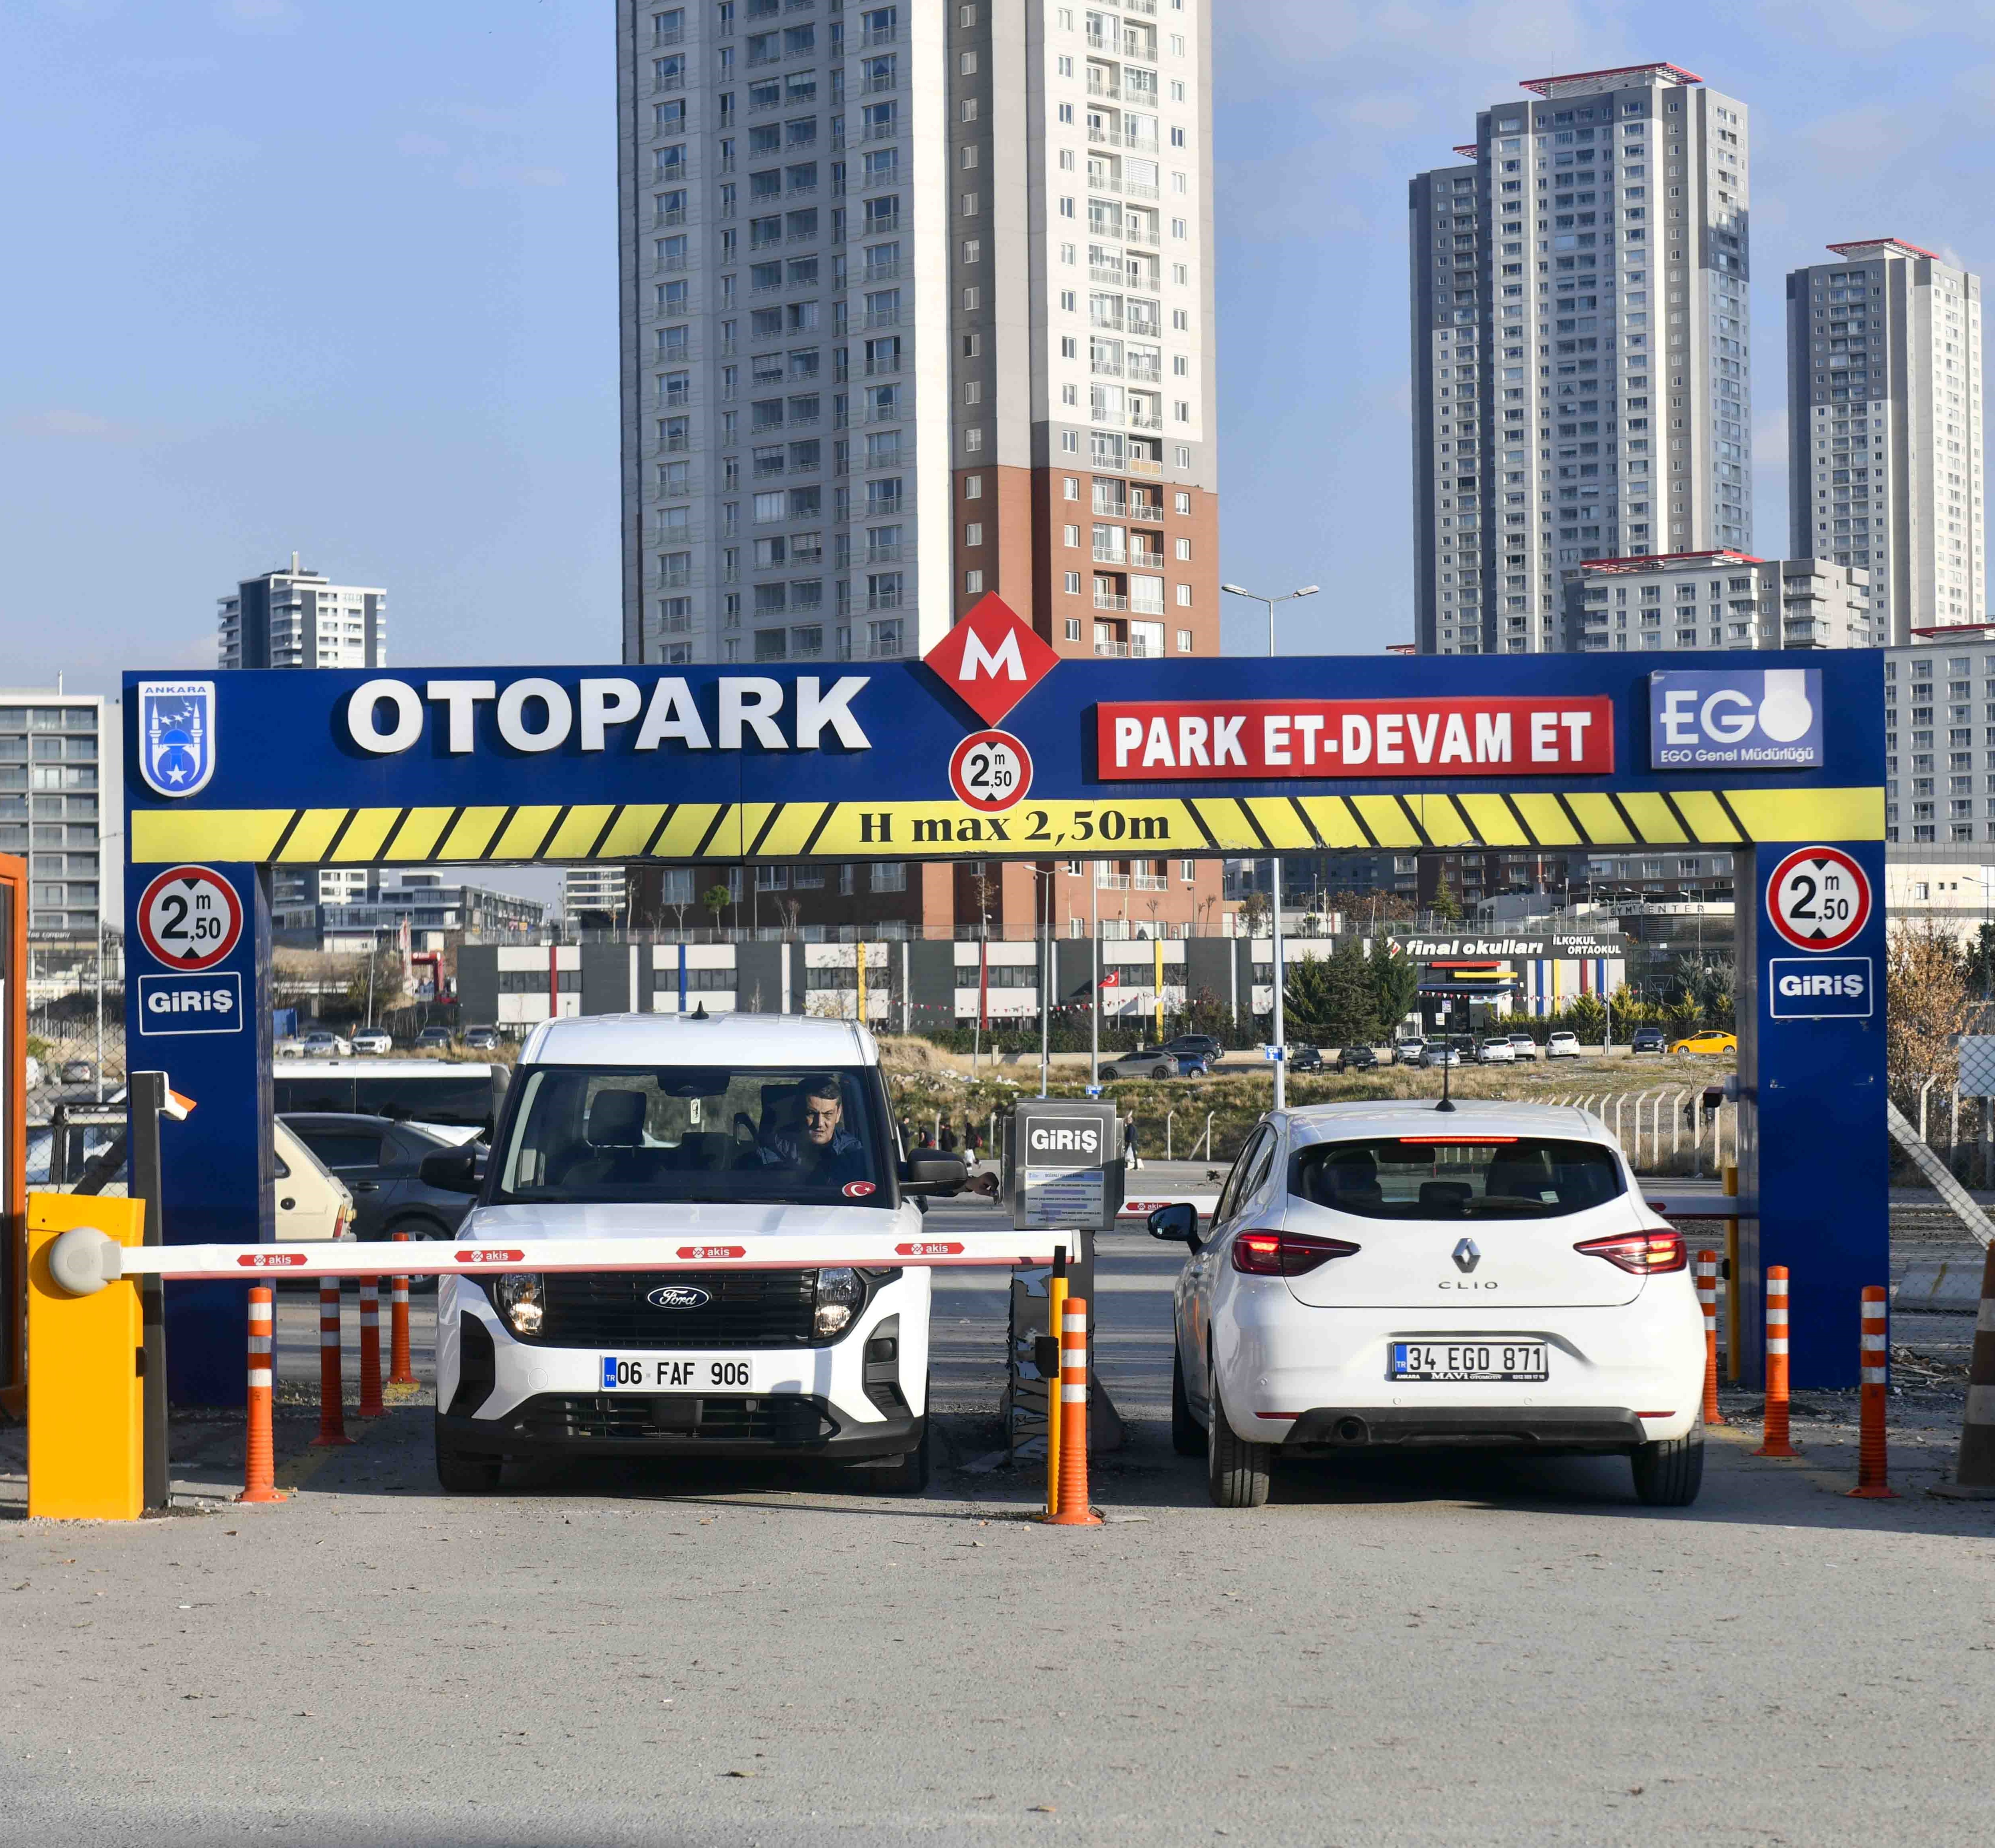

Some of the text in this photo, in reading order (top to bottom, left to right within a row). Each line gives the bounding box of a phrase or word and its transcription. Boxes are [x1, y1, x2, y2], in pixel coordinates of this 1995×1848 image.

[959, 626, 1027, 680] M
[347, 676, 872, 753] OTOPARK
[1115, 712, 1592, 767] PARK ET-DEVAM ET
[1661, 746, 1814, 762] EGO Genel Müdürlüğü
[859, 810, 1170, 847] H max 2,50m
[1639, 904, 1704, 914] CENTER
[1406, 939, 1543, 955] final okulları
[1553, 934, 1596, 945] İLKOKUL
[1568, 945, 1622, 955] ORTAOKUL
[486, 1250, 509, 1260] akis
[707, 1247, 730, 1256] akis
[925, 1243, 948, 1253] akis
[269, 1255, 291, 1264] akis
[1438, 1281, 1498, 1289] CLIO
[659, 1289, 697, 1305] Ford
[1409, 1348, 1436, 1370] 34
[1504, 1348, 1540, 1370] 871
[617, 1362, 749, 1385] 06 FAF 906
